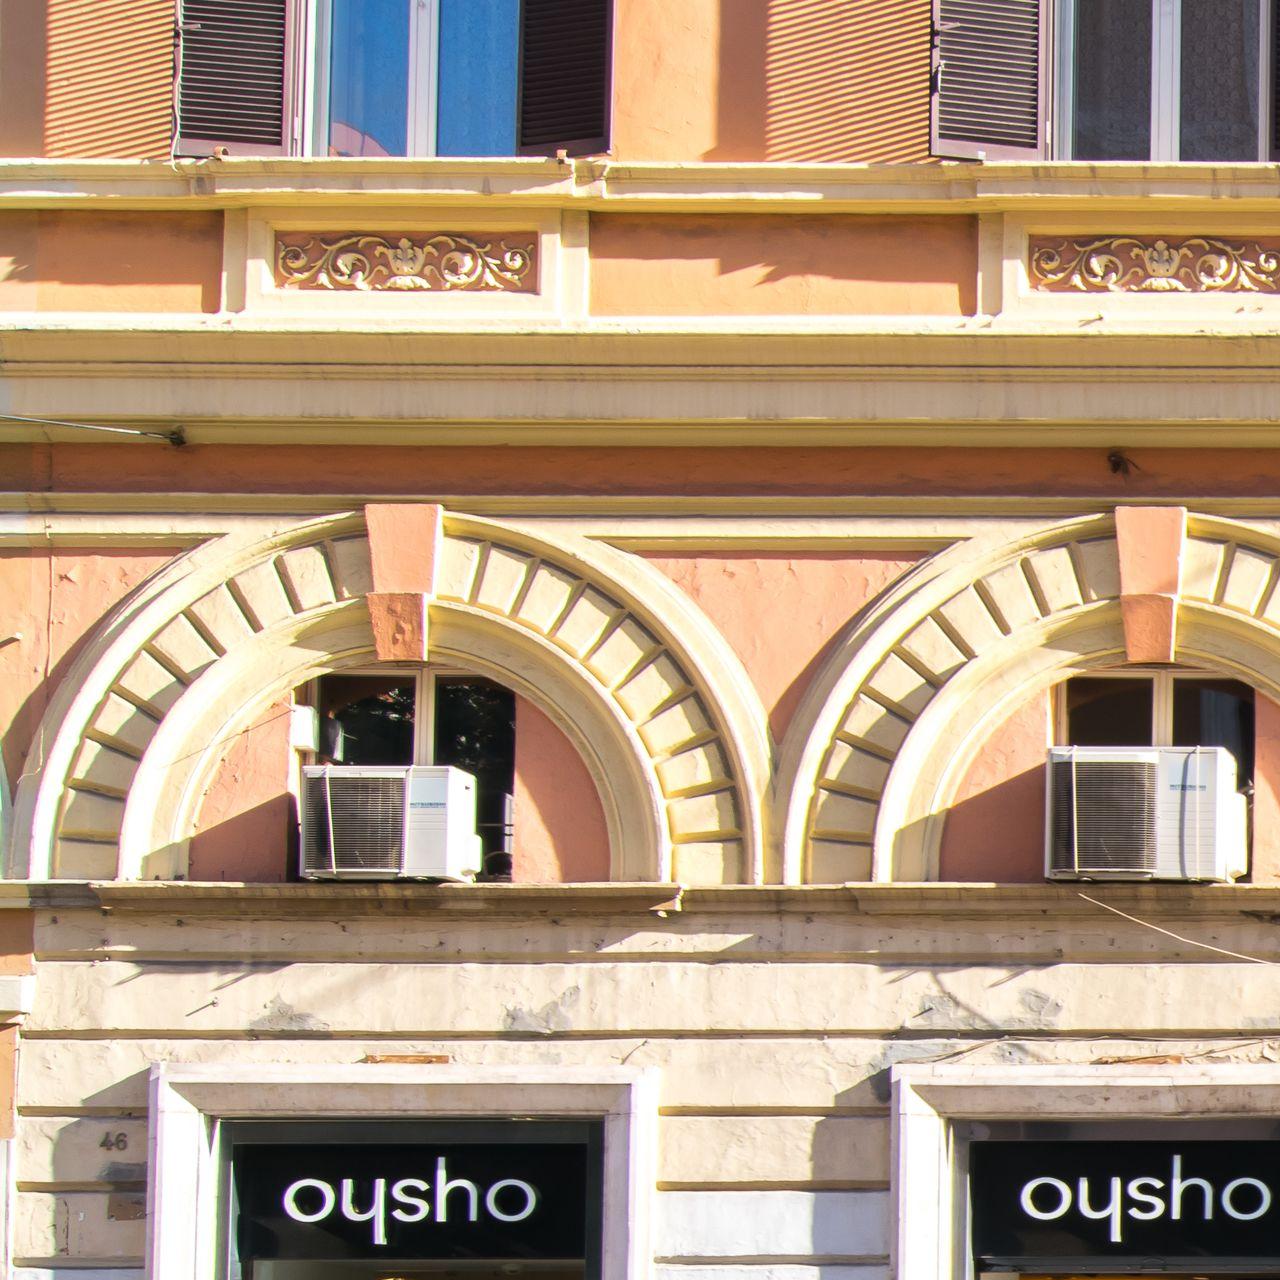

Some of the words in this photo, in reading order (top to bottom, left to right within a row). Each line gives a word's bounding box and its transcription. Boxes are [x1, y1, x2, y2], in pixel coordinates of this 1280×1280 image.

[100, 1132, 127, 1151] 46
[282, 1156, 538, 1245] oysho
[1020, 1154, 1273, 1243] oysho
